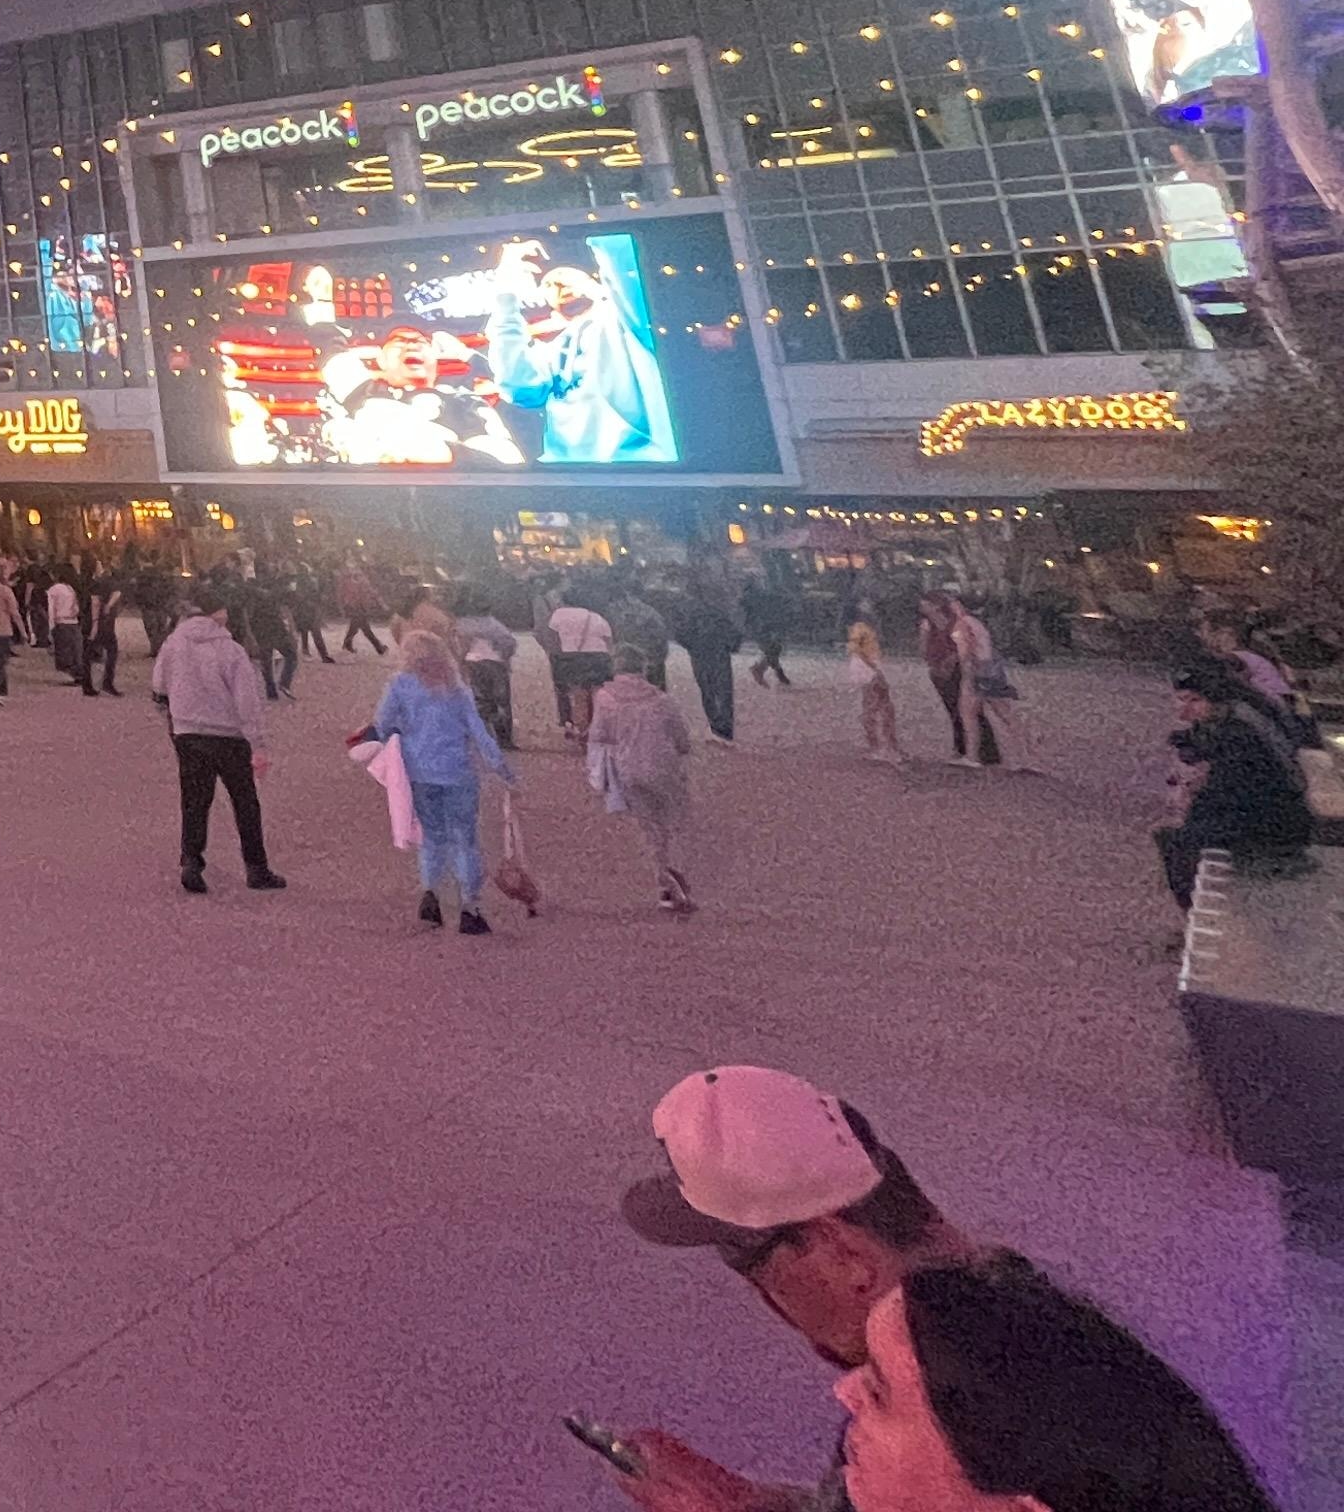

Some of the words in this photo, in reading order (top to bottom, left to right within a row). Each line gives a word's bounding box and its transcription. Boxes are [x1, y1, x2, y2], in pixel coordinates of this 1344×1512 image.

[415, 75, 585, 141] peacock
[199, 108, 343, 168] peacock
[25, 398, 82, 433] DOG
[979, 403, 1067, 424] LAZY
[1081, 399, 1160, 422] DOG
